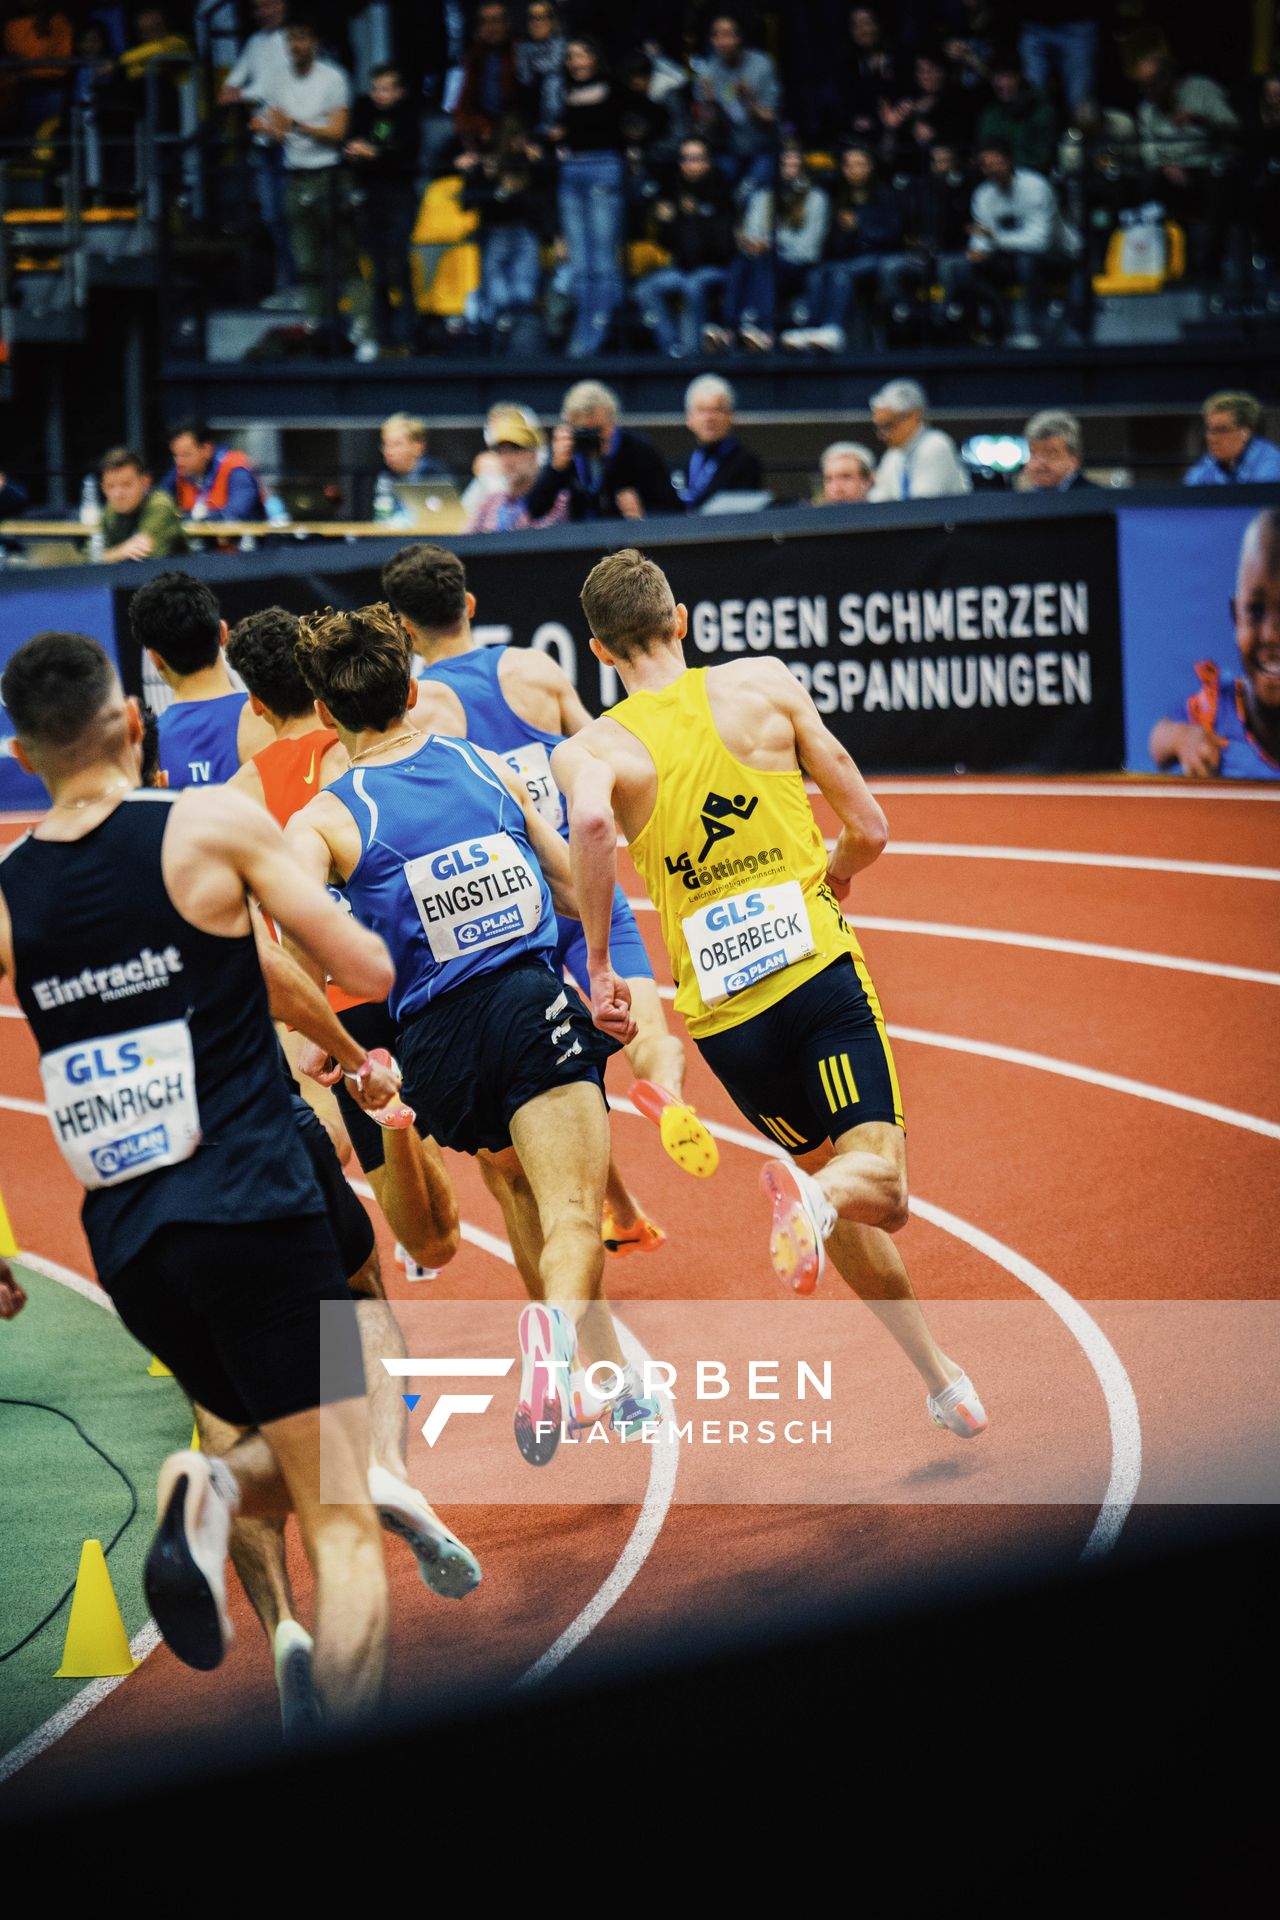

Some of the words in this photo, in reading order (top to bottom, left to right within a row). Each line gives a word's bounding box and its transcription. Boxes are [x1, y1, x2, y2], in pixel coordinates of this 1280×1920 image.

[692, 594, 829, 653] GEGEN
[838, 581, 1090, 647] SCHMERZEN
[188, 761, 211, 782] TV
[664, 852, 692, 875] LG
[682, 847, 783, 890] Göttingen
[422, 865, 533, 923] ENGSTLER
[481, 910, 519, 932] PLAN
[699, 912, 803, 972] OBERBECK
[31, 944, 184, 1011] Eintracht
[748, 953, 785, 978] PLAN
[54, 1072, 185, 1142] HEINRICH
